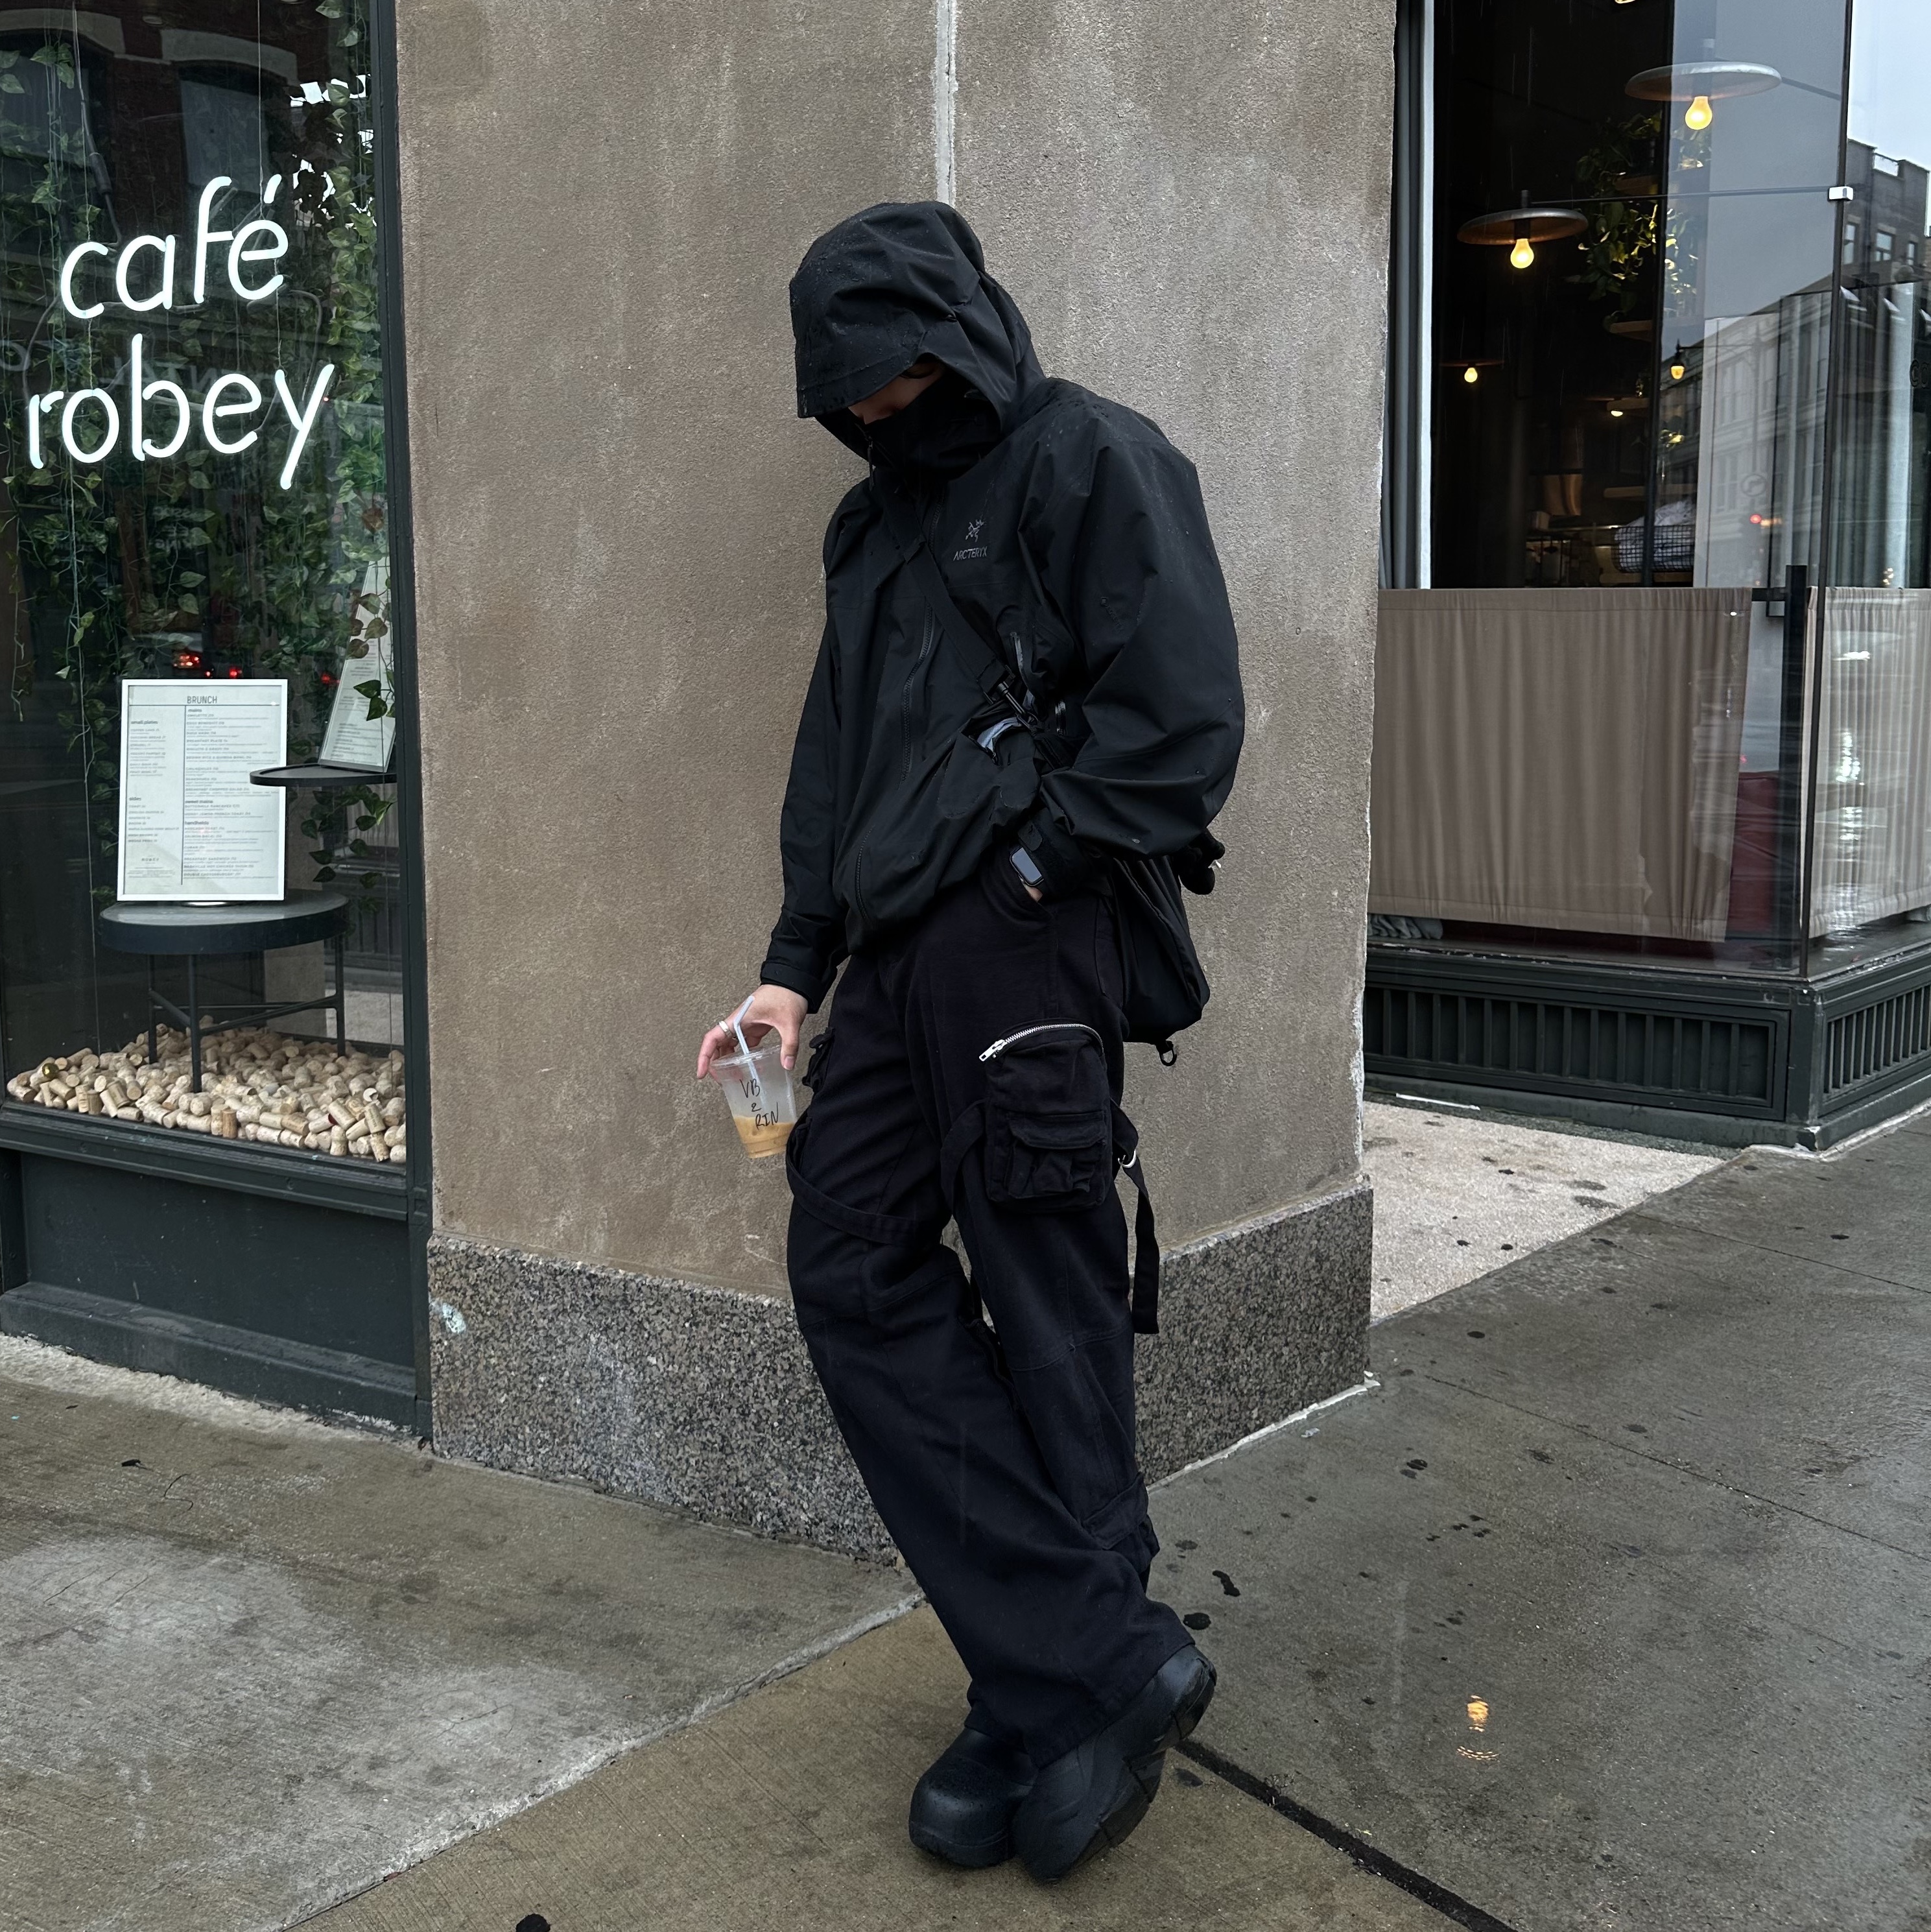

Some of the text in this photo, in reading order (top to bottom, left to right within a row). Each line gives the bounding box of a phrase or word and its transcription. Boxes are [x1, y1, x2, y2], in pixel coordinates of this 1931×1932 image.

[60, 174, 289, 319] café
[29, 333, 335, 490] robey
[187, 695, 218, 704] BRUNCH
[739, 1078, 761, 1099] VB
